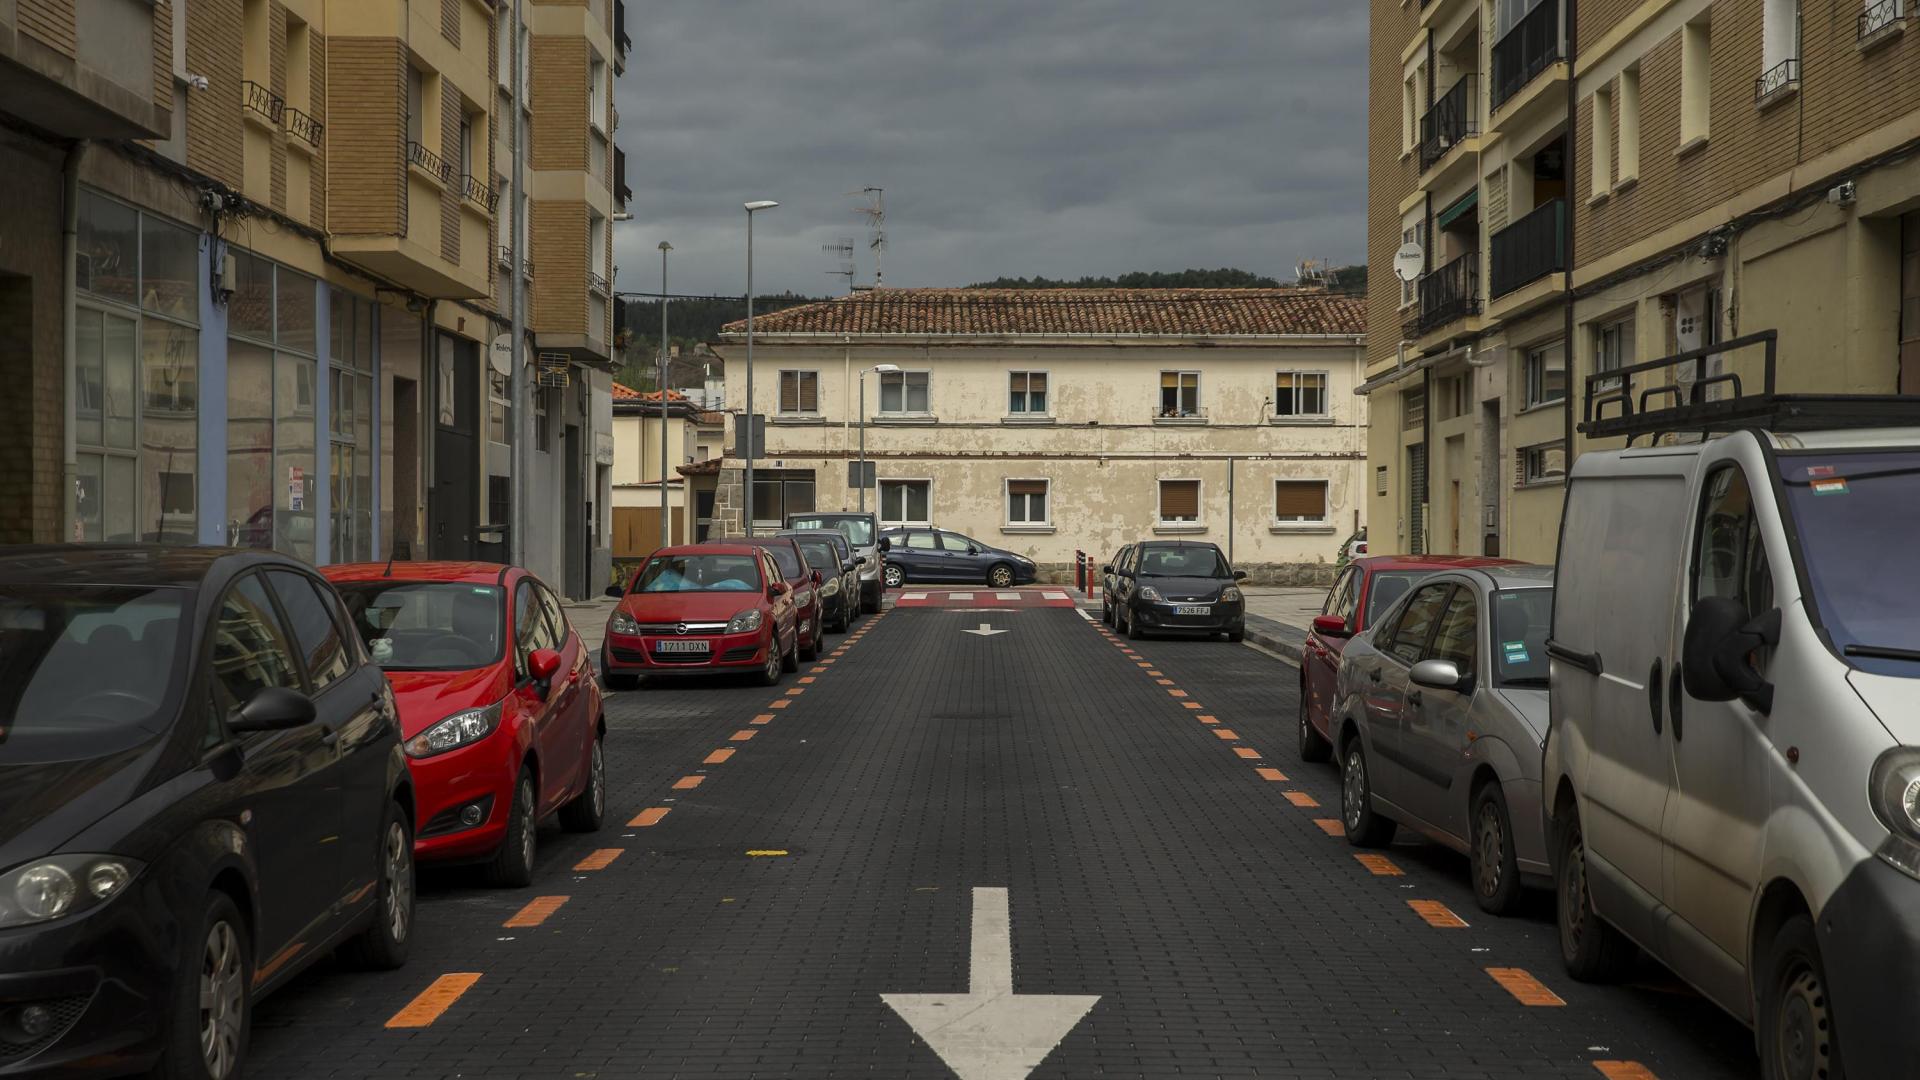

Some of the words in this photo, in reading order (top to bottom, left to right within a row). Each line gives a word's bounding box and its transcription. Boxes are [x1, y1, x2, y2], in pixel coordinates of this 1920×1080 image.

[495, 343, 512, 352] Telev
[663, 642, 686, 651] 1711
[688, 642, 707, 651] DXN
